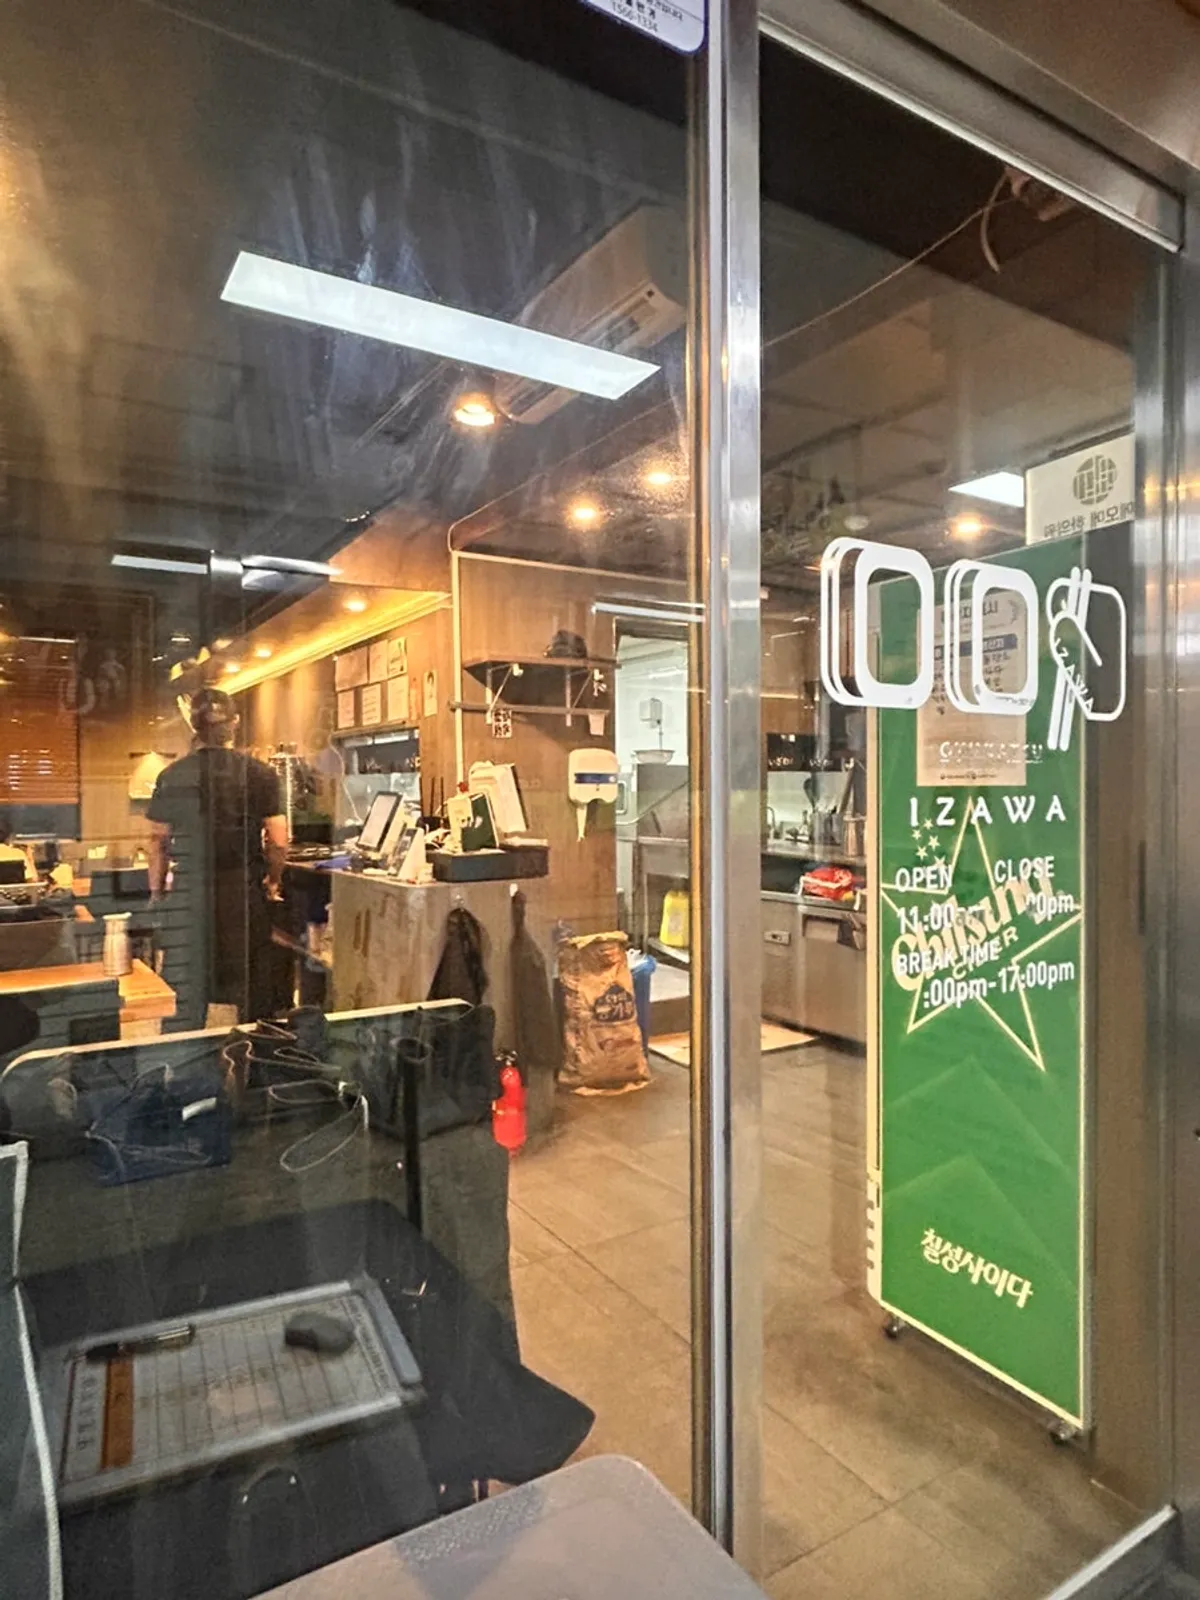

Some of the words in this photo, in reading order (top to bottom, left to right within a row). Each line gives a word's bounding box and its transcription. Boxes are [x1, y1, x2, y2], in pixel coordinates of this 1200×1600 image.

[910, 795, 1066, 827] IZAWA
[895, 865, 952, 892] OPEN
[994, 856, 1055, 883] CLOSE
[896, 949, 955, 976] BREAK
[959, 940, 1000, 965] TIME
[921, 1228, 1034, 1308] 칠성사이다
